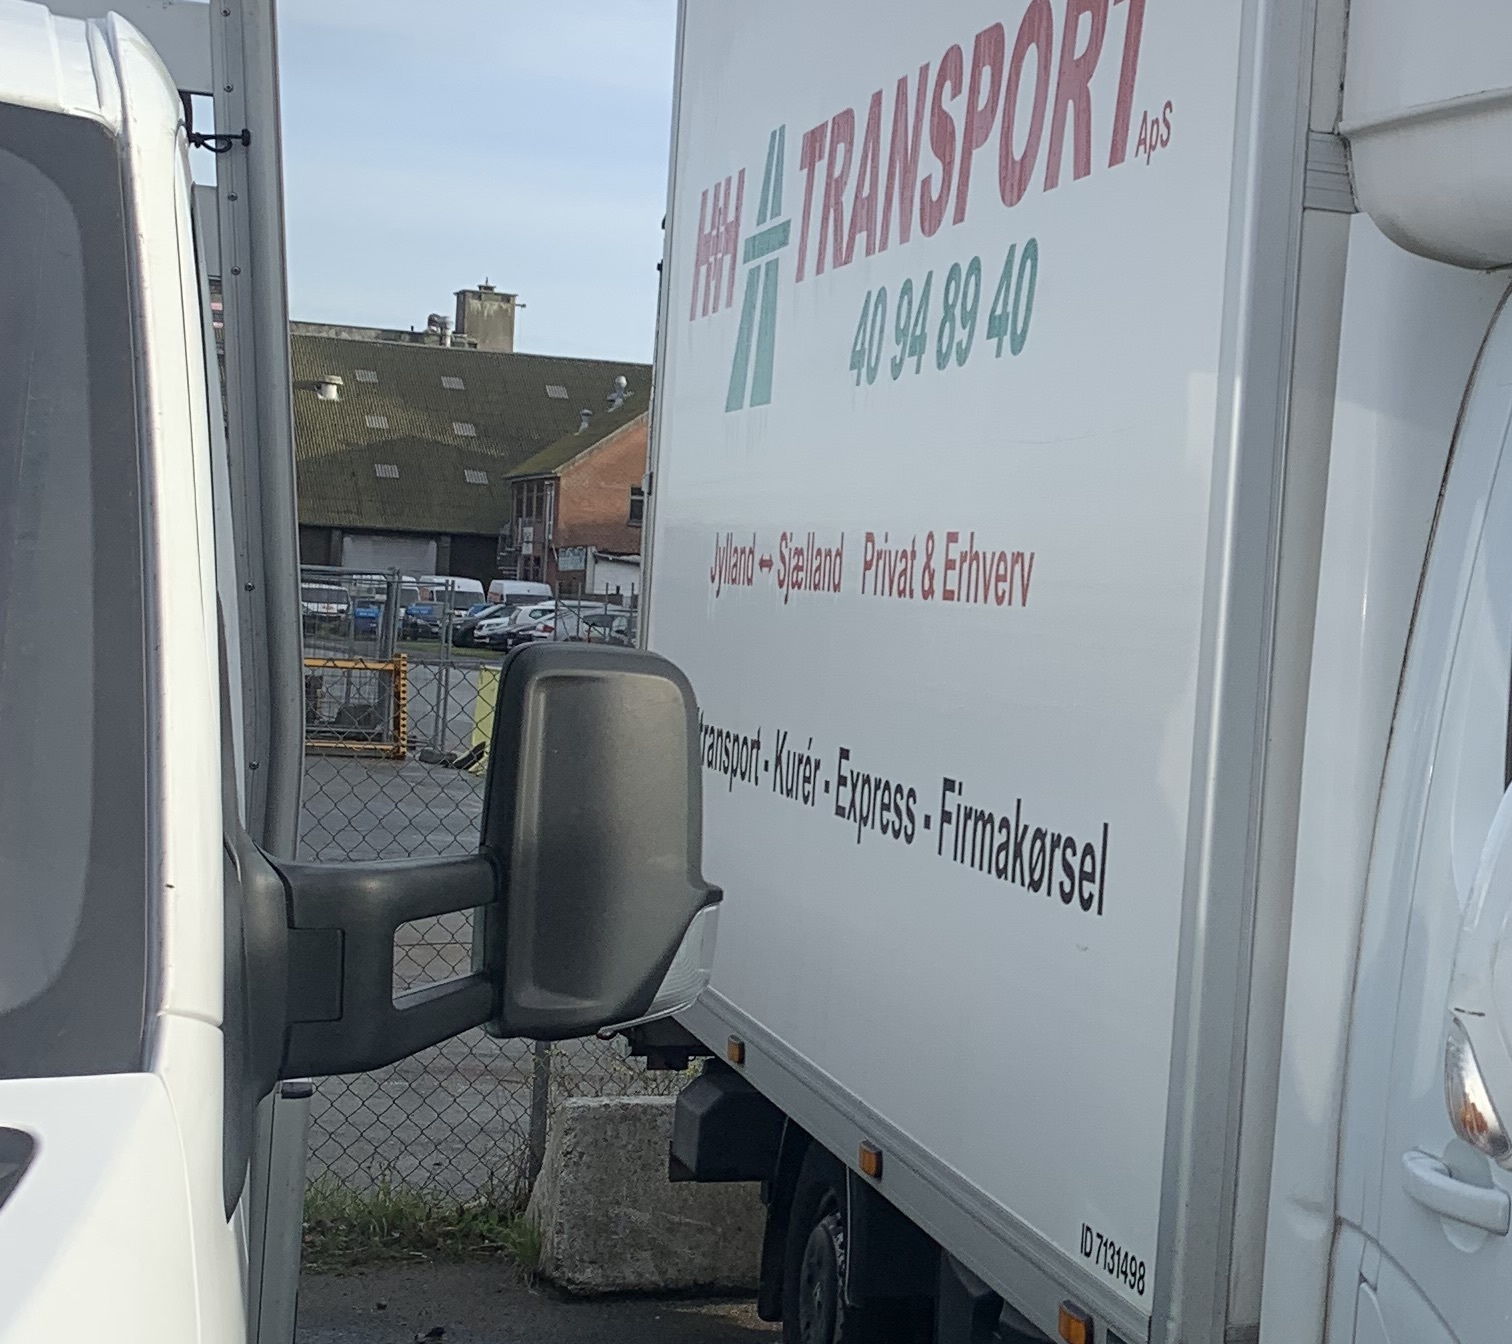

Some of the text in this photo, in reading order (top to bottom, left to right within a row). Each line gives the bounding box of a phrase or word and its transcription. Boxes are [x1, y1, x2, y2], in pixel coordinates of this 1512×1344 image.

[1135, 100, 1174, 166] ApS
[849, 237, 1039, 388] 40 94 89 40
[710, 531, 844, 605] Jylland Sjælland
[862, 531, 1035, 607] Privat & Erhverv
[773, 728, 821, 807] Kurér
[835, 747, 918, 844] Express
[938, 777, 1109, 916] Firmakørsel
[1080, 1222, 1145, 1296] ID 7131498
